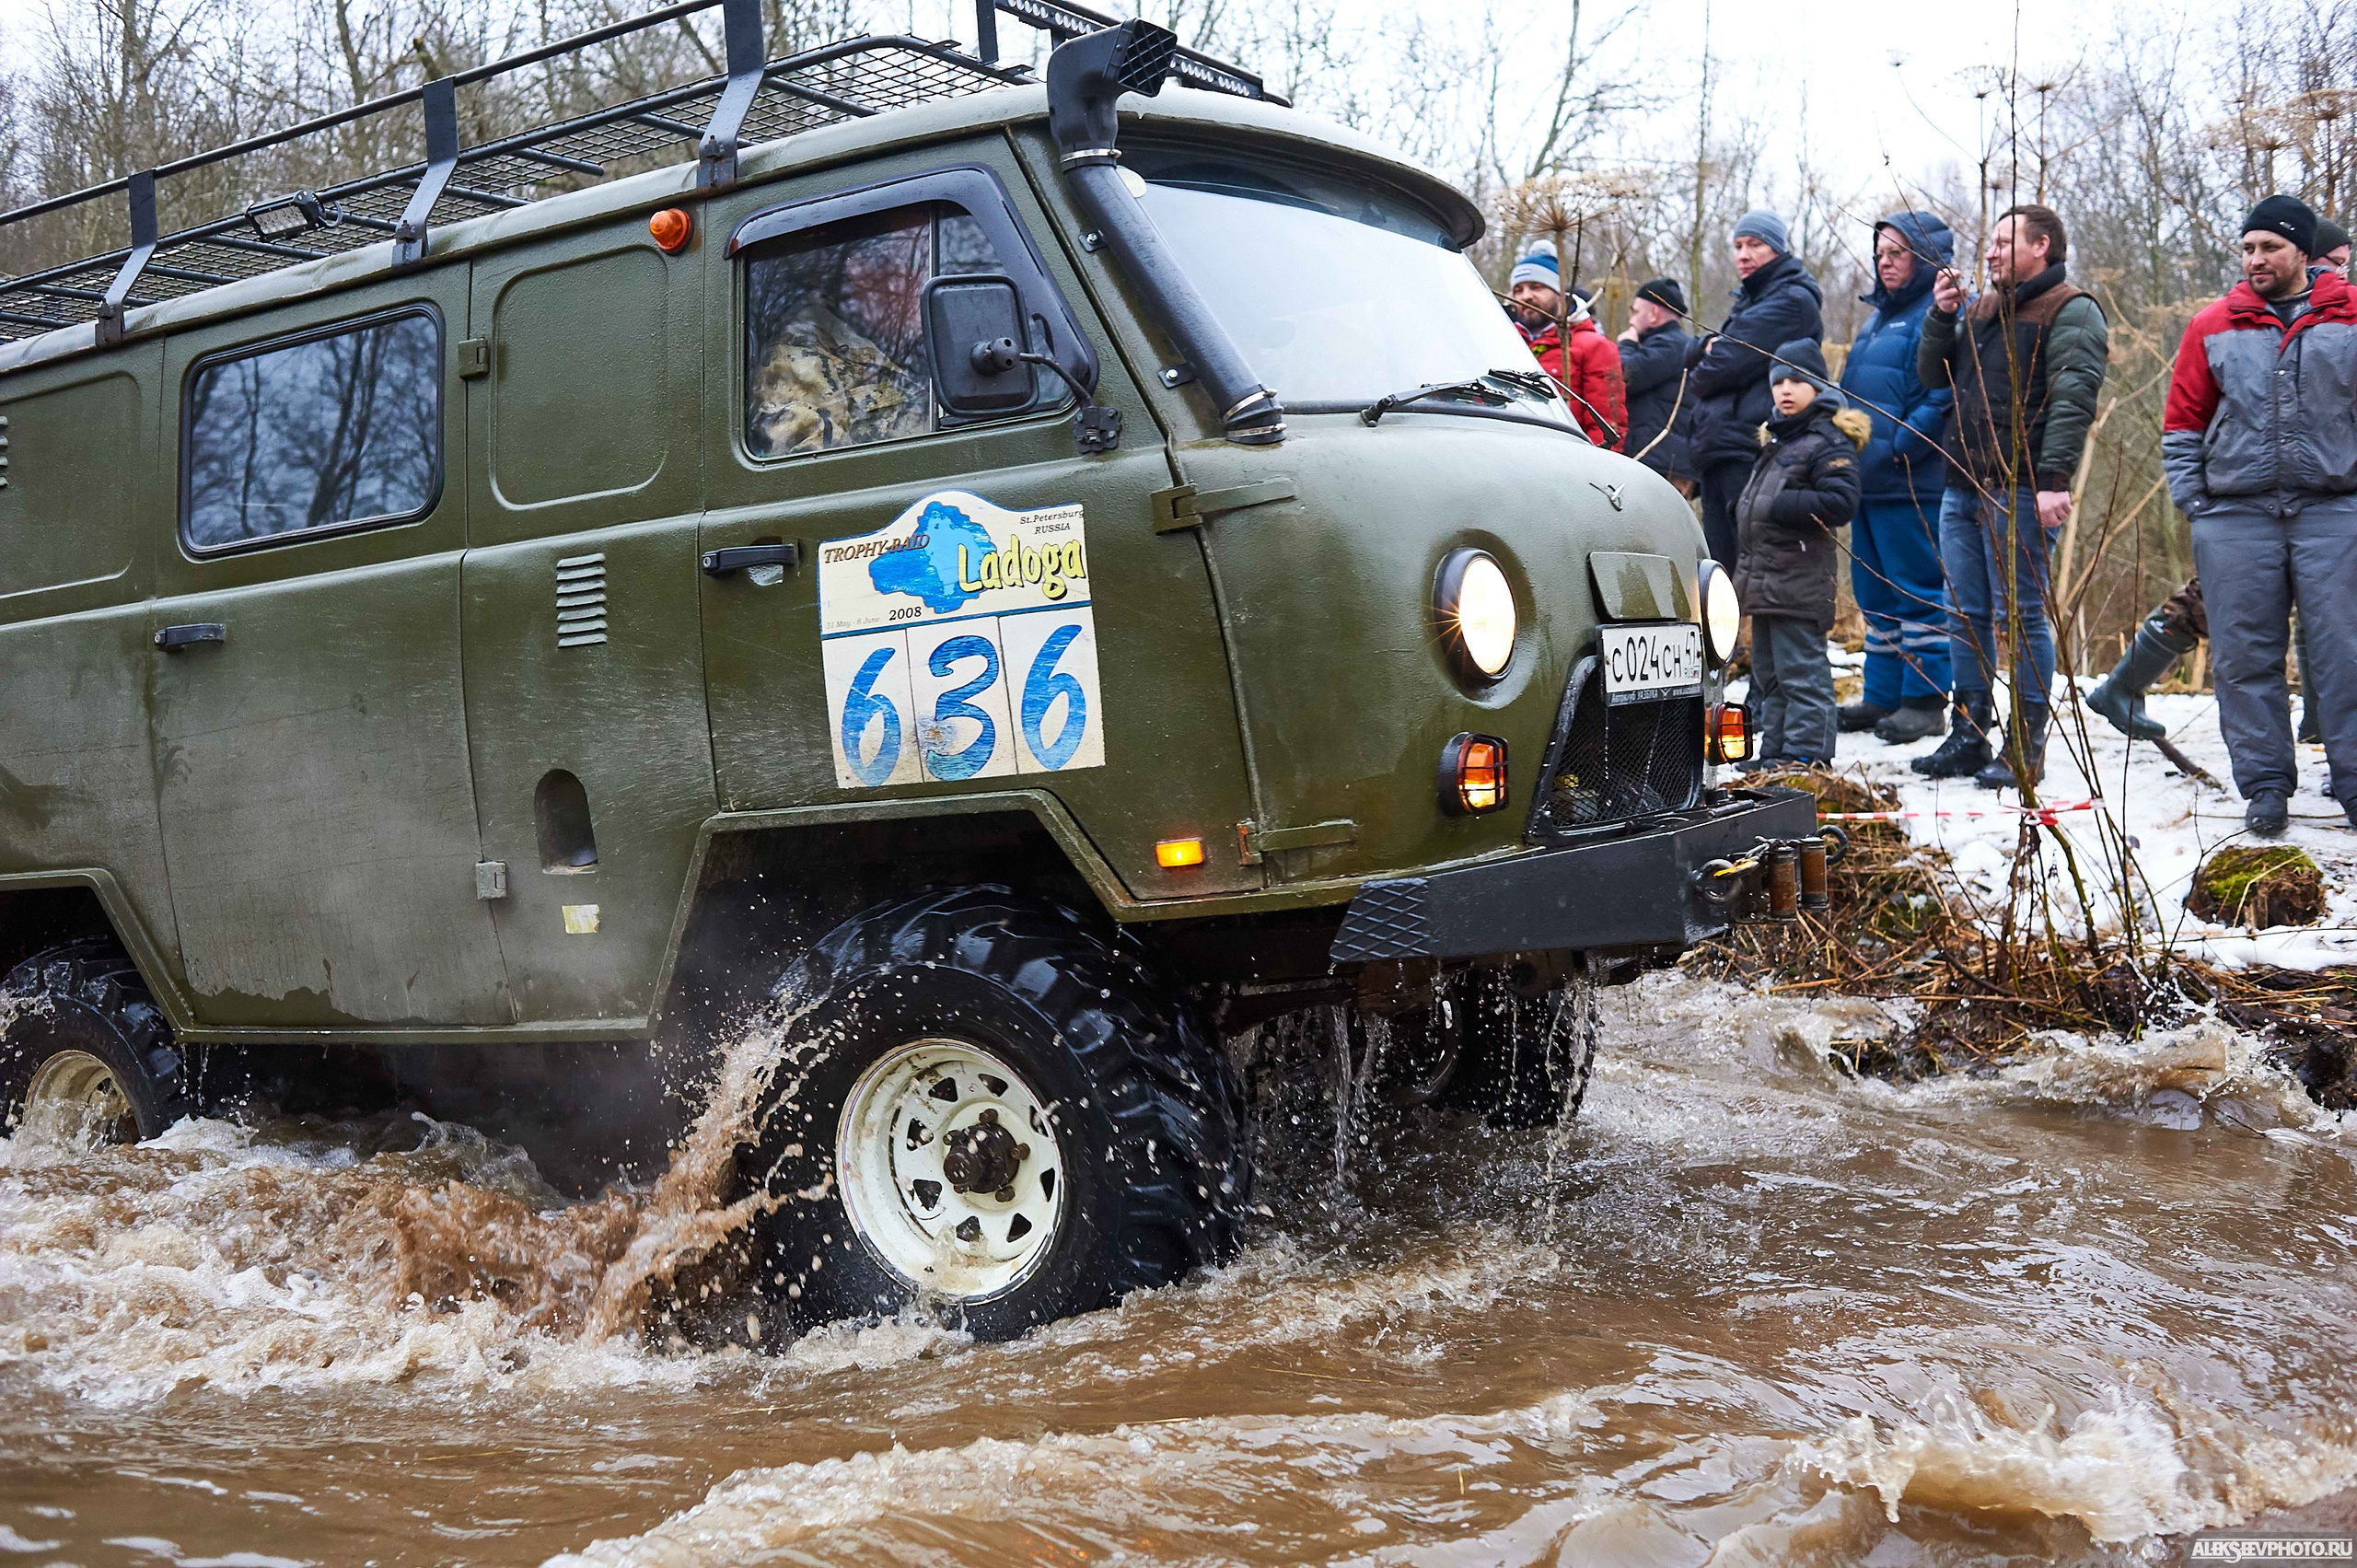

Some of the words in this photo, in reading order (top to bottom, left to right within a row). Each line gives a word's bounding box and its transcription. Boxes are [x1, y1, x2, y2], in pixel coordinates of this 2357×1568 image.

[1035, 522, 1070, 534] RUSSIA
[824, 534, 930, 563] TROPHY-RAID
[958, 533, 1086, 600] Ladoga
[836, 619, 852, 629] May
[863, 616, 880, 624] June
[888, 606, 922, 621] 2008
